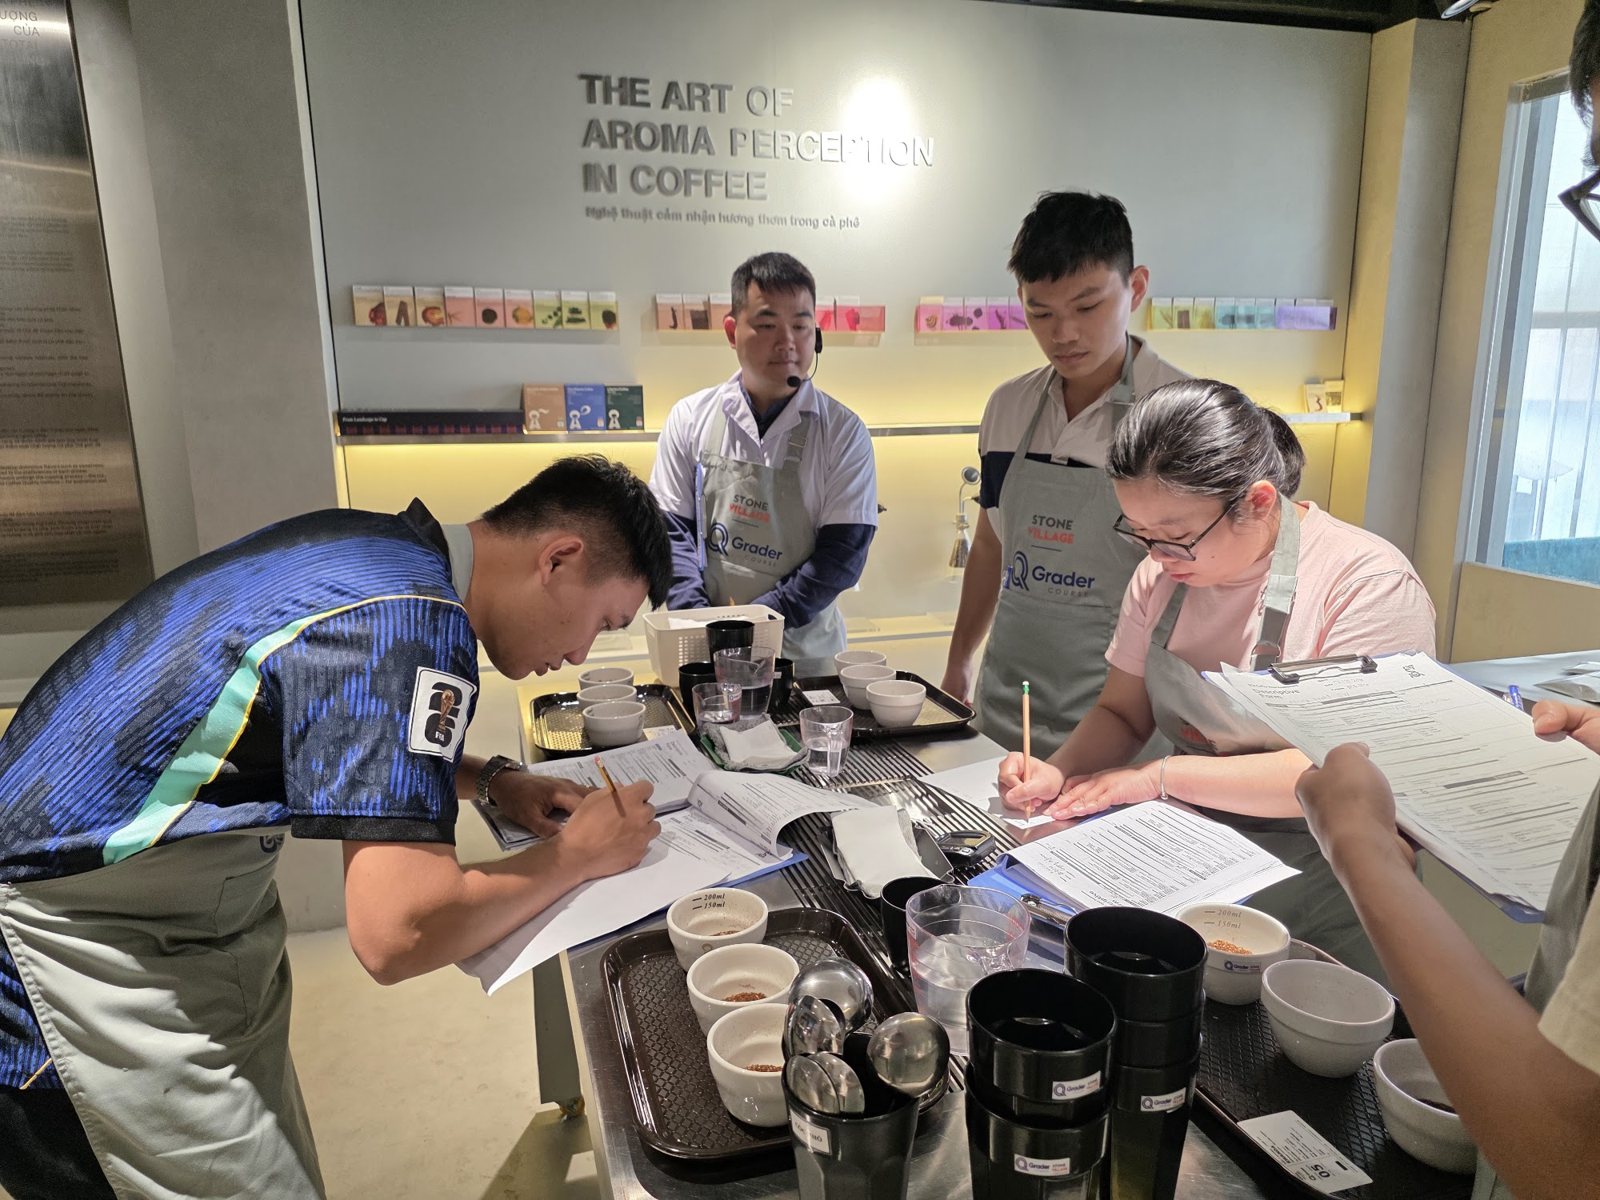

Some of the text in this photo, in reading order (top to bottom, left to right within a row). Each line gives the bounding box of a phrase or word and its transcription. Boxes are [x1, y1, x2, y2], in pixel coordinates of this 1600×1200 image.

[578, 73, 794, 117] THE ART OF
[581, 118, 716, 156] AROMA
[582, 162, 768, 201] IN COFFEE
[620, 207, 654, 224] thuật
[685, 209, 716, 226] nhận
[718, 211, 754, 227] hương
[757, 213, 788, 227] thơm
[790, 214, 820, 230] trong
[822, 215, 836, 228] cà
[838, 216, 861, 230] phê
[734, 494, 768, 511] STONE
[1032, 515, 1073, 530] STONE
[731, 536, 783, 561] Grader
[1031, 565, 1096, 589] Grader
[704, 893, 725, 901] 200ml
[704, 901, 725, 909] 150ml
[1217, 909, 1242, 918] 200ml
[1217, 919, 1242, 929] 150ml
[1310, 1163, 1331, 1178] 05
